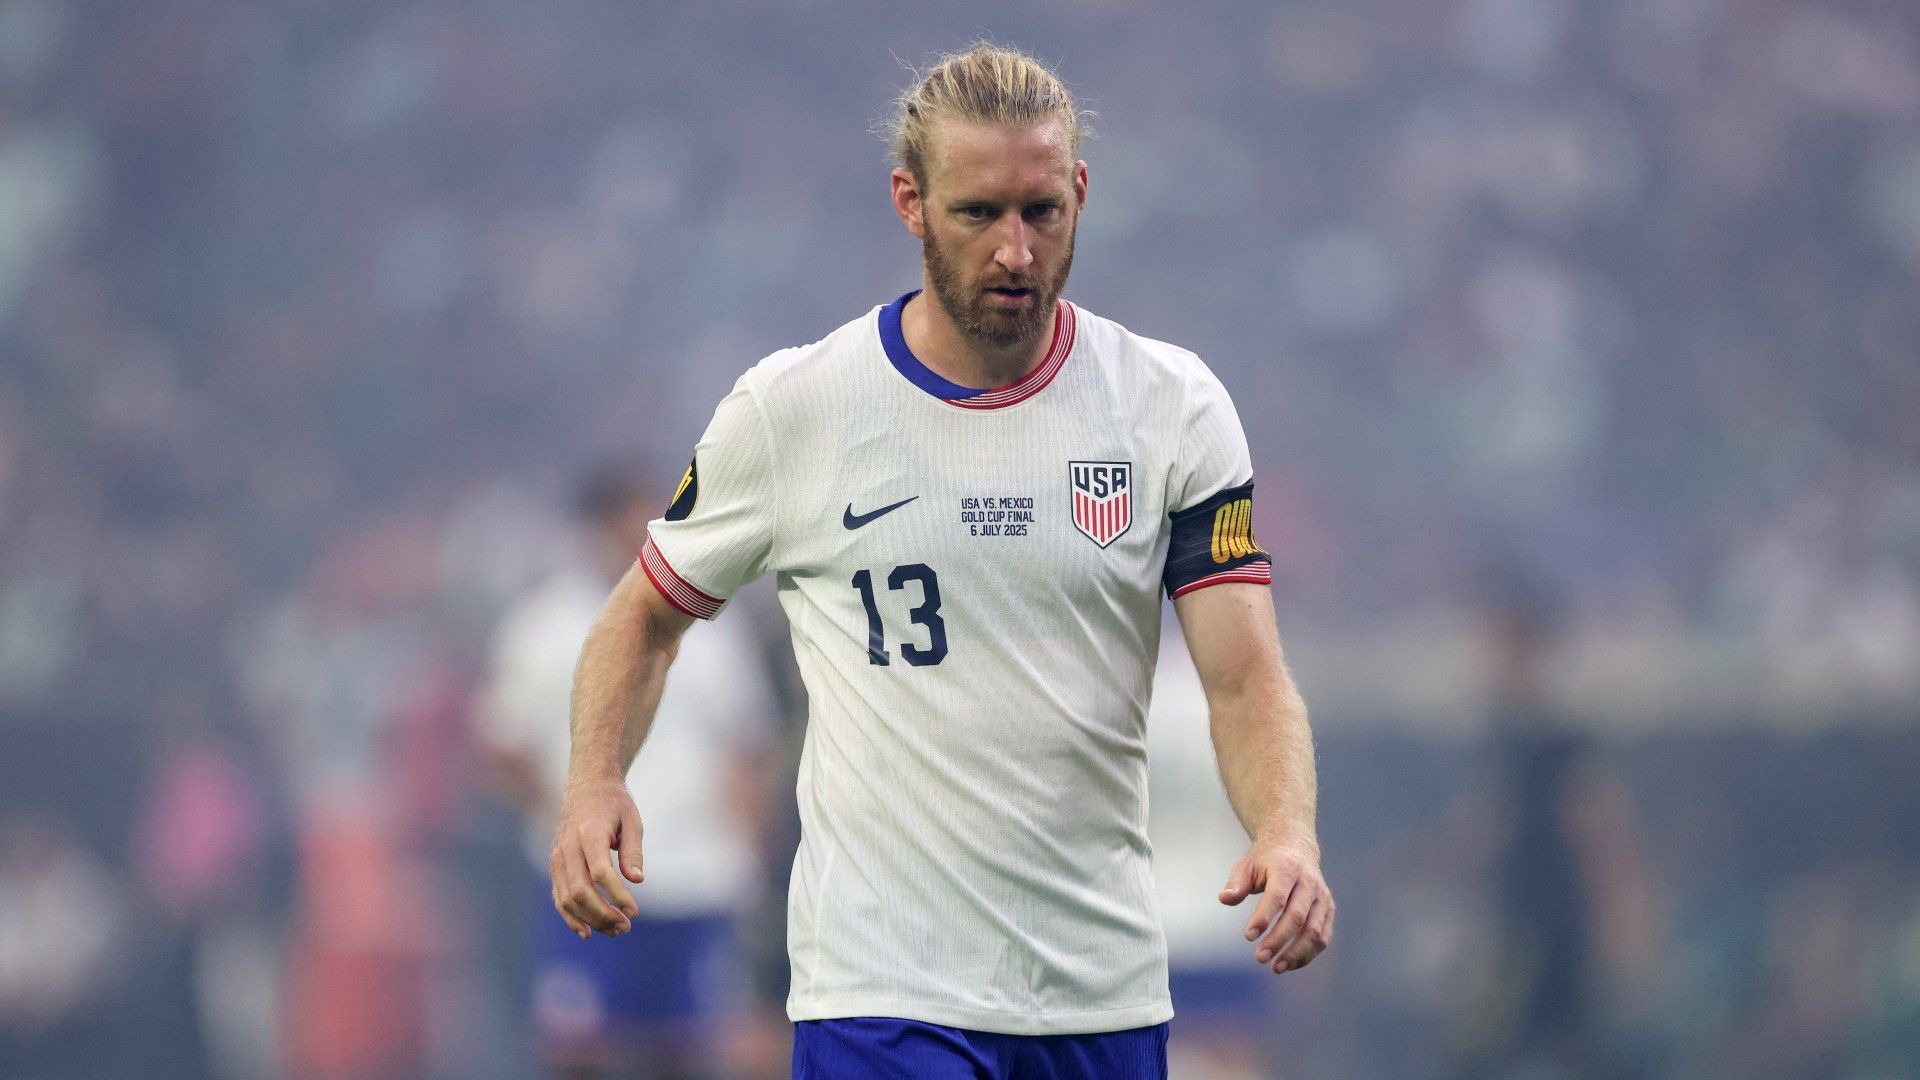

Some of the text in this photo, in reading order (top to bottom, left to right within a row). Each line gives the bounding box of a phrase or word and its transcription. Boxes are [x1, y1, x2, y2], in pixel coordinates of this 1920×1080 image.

[1074, 467, 1127, 498] USA
[961, 497, 1034, 509] USA VS. MEXICO
[961, 511, 1035, 523] GOLD CUP FINAL
[970, 524, 1028, 536] 6 JULY 2025
[851, 563, 948, 667] 13
